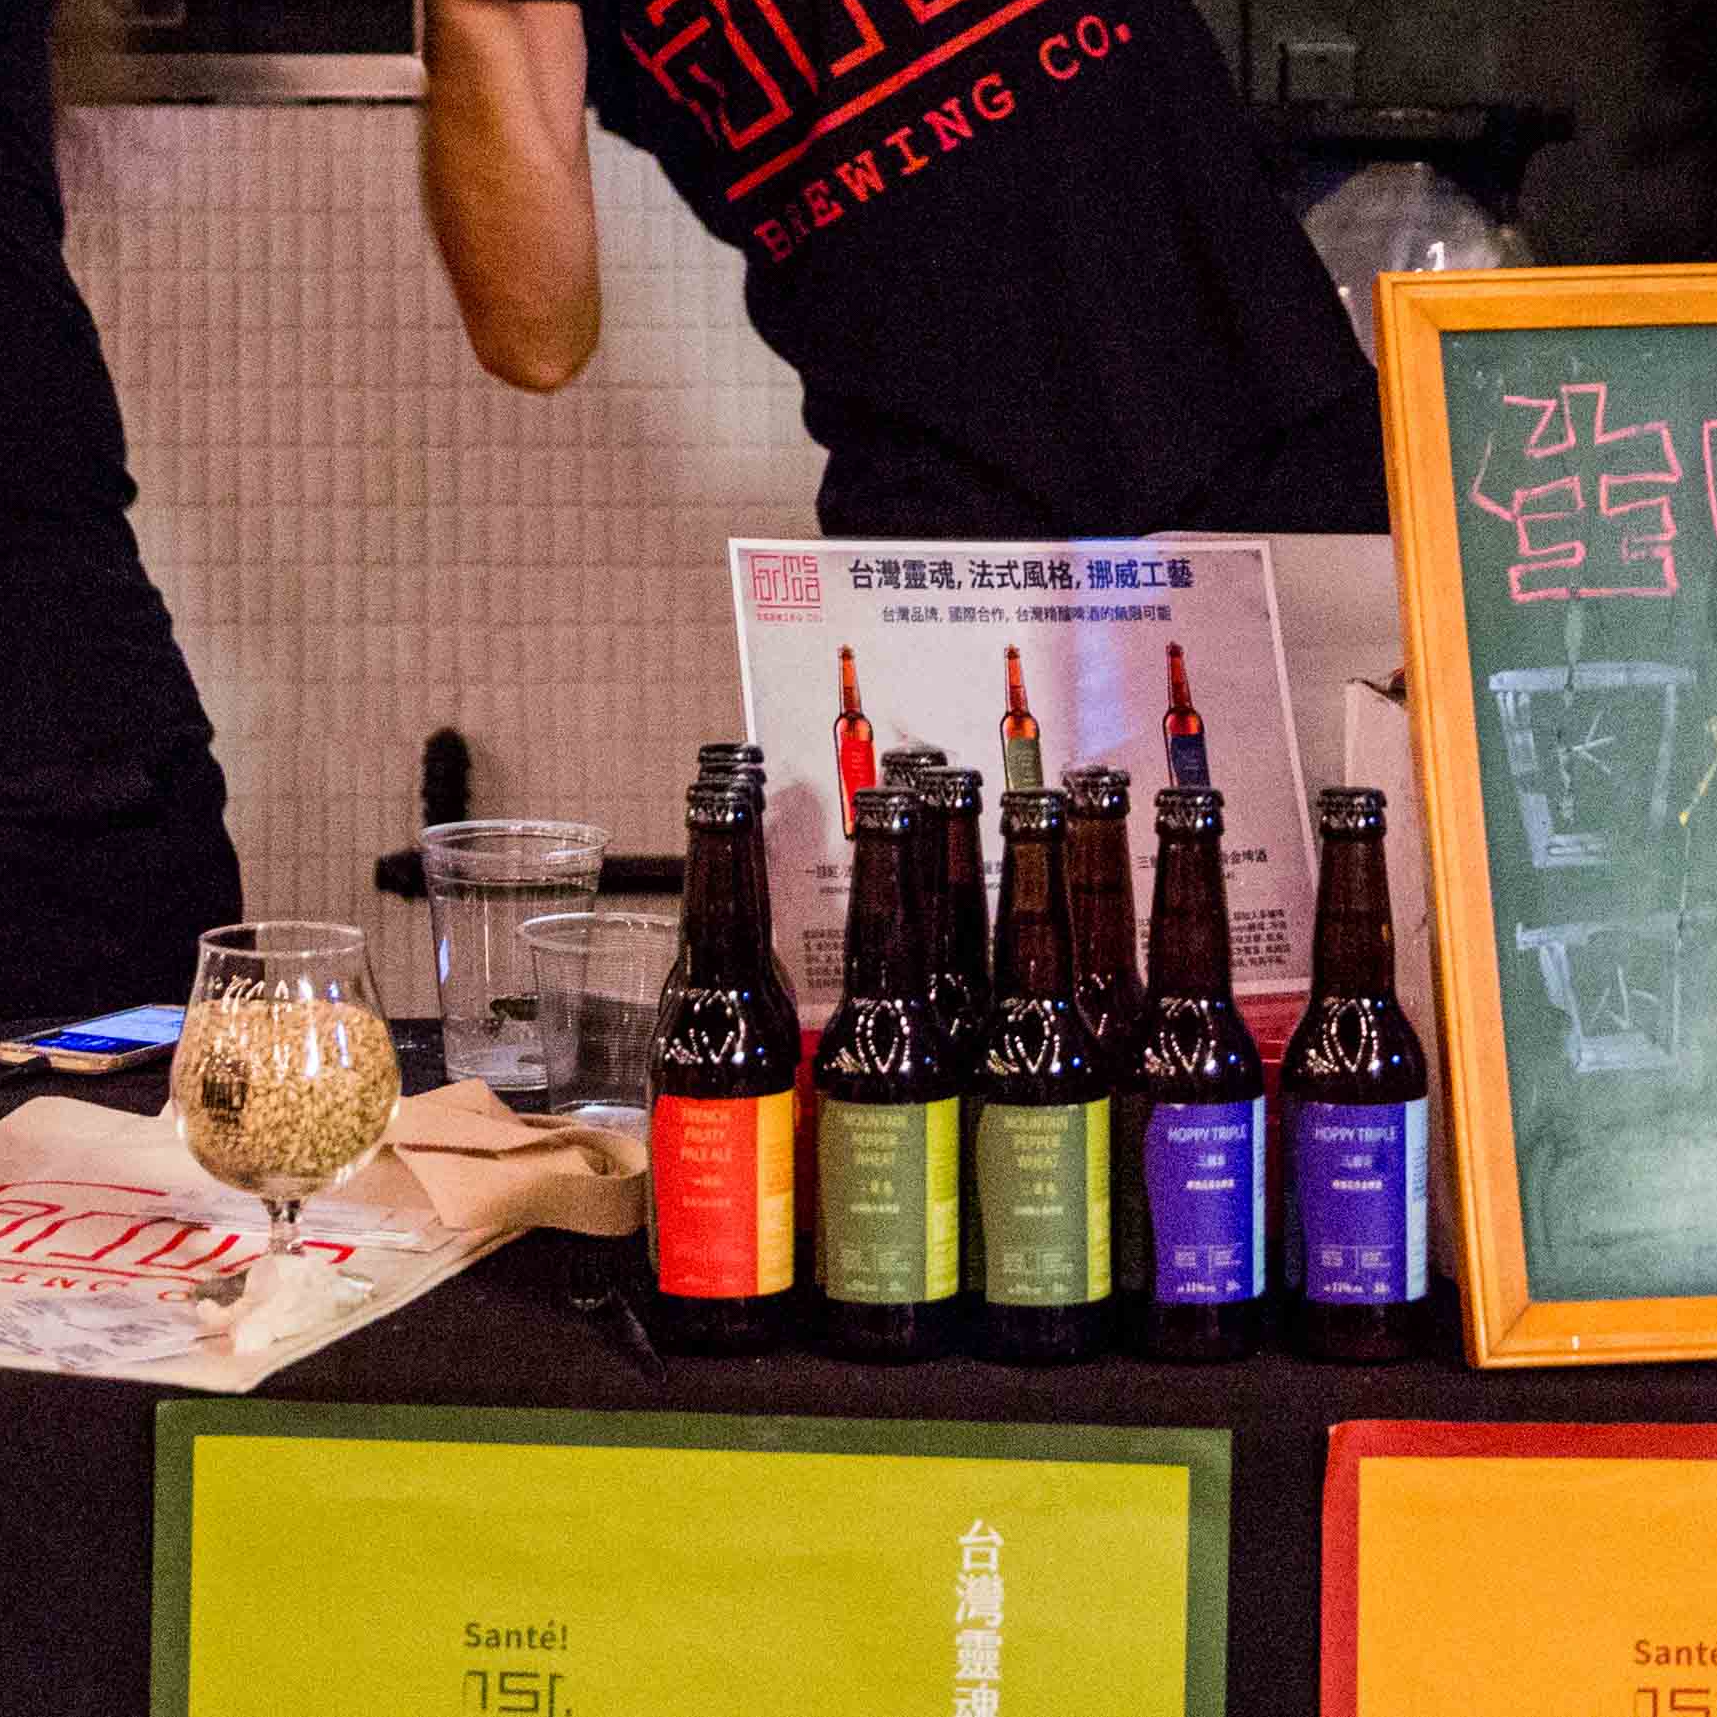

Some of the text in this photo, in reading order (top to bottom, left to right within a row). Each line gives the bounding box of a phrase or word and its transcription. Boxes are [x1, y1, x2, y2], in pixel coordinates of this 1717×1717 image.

[1039, 14, 1133, 80] CO.
[1167, 1126, 1211, 1142] HOPPY
[1315, 1126, 1358, 1142] HOPPY
[464, 1619, 568, 1650] Santé!
